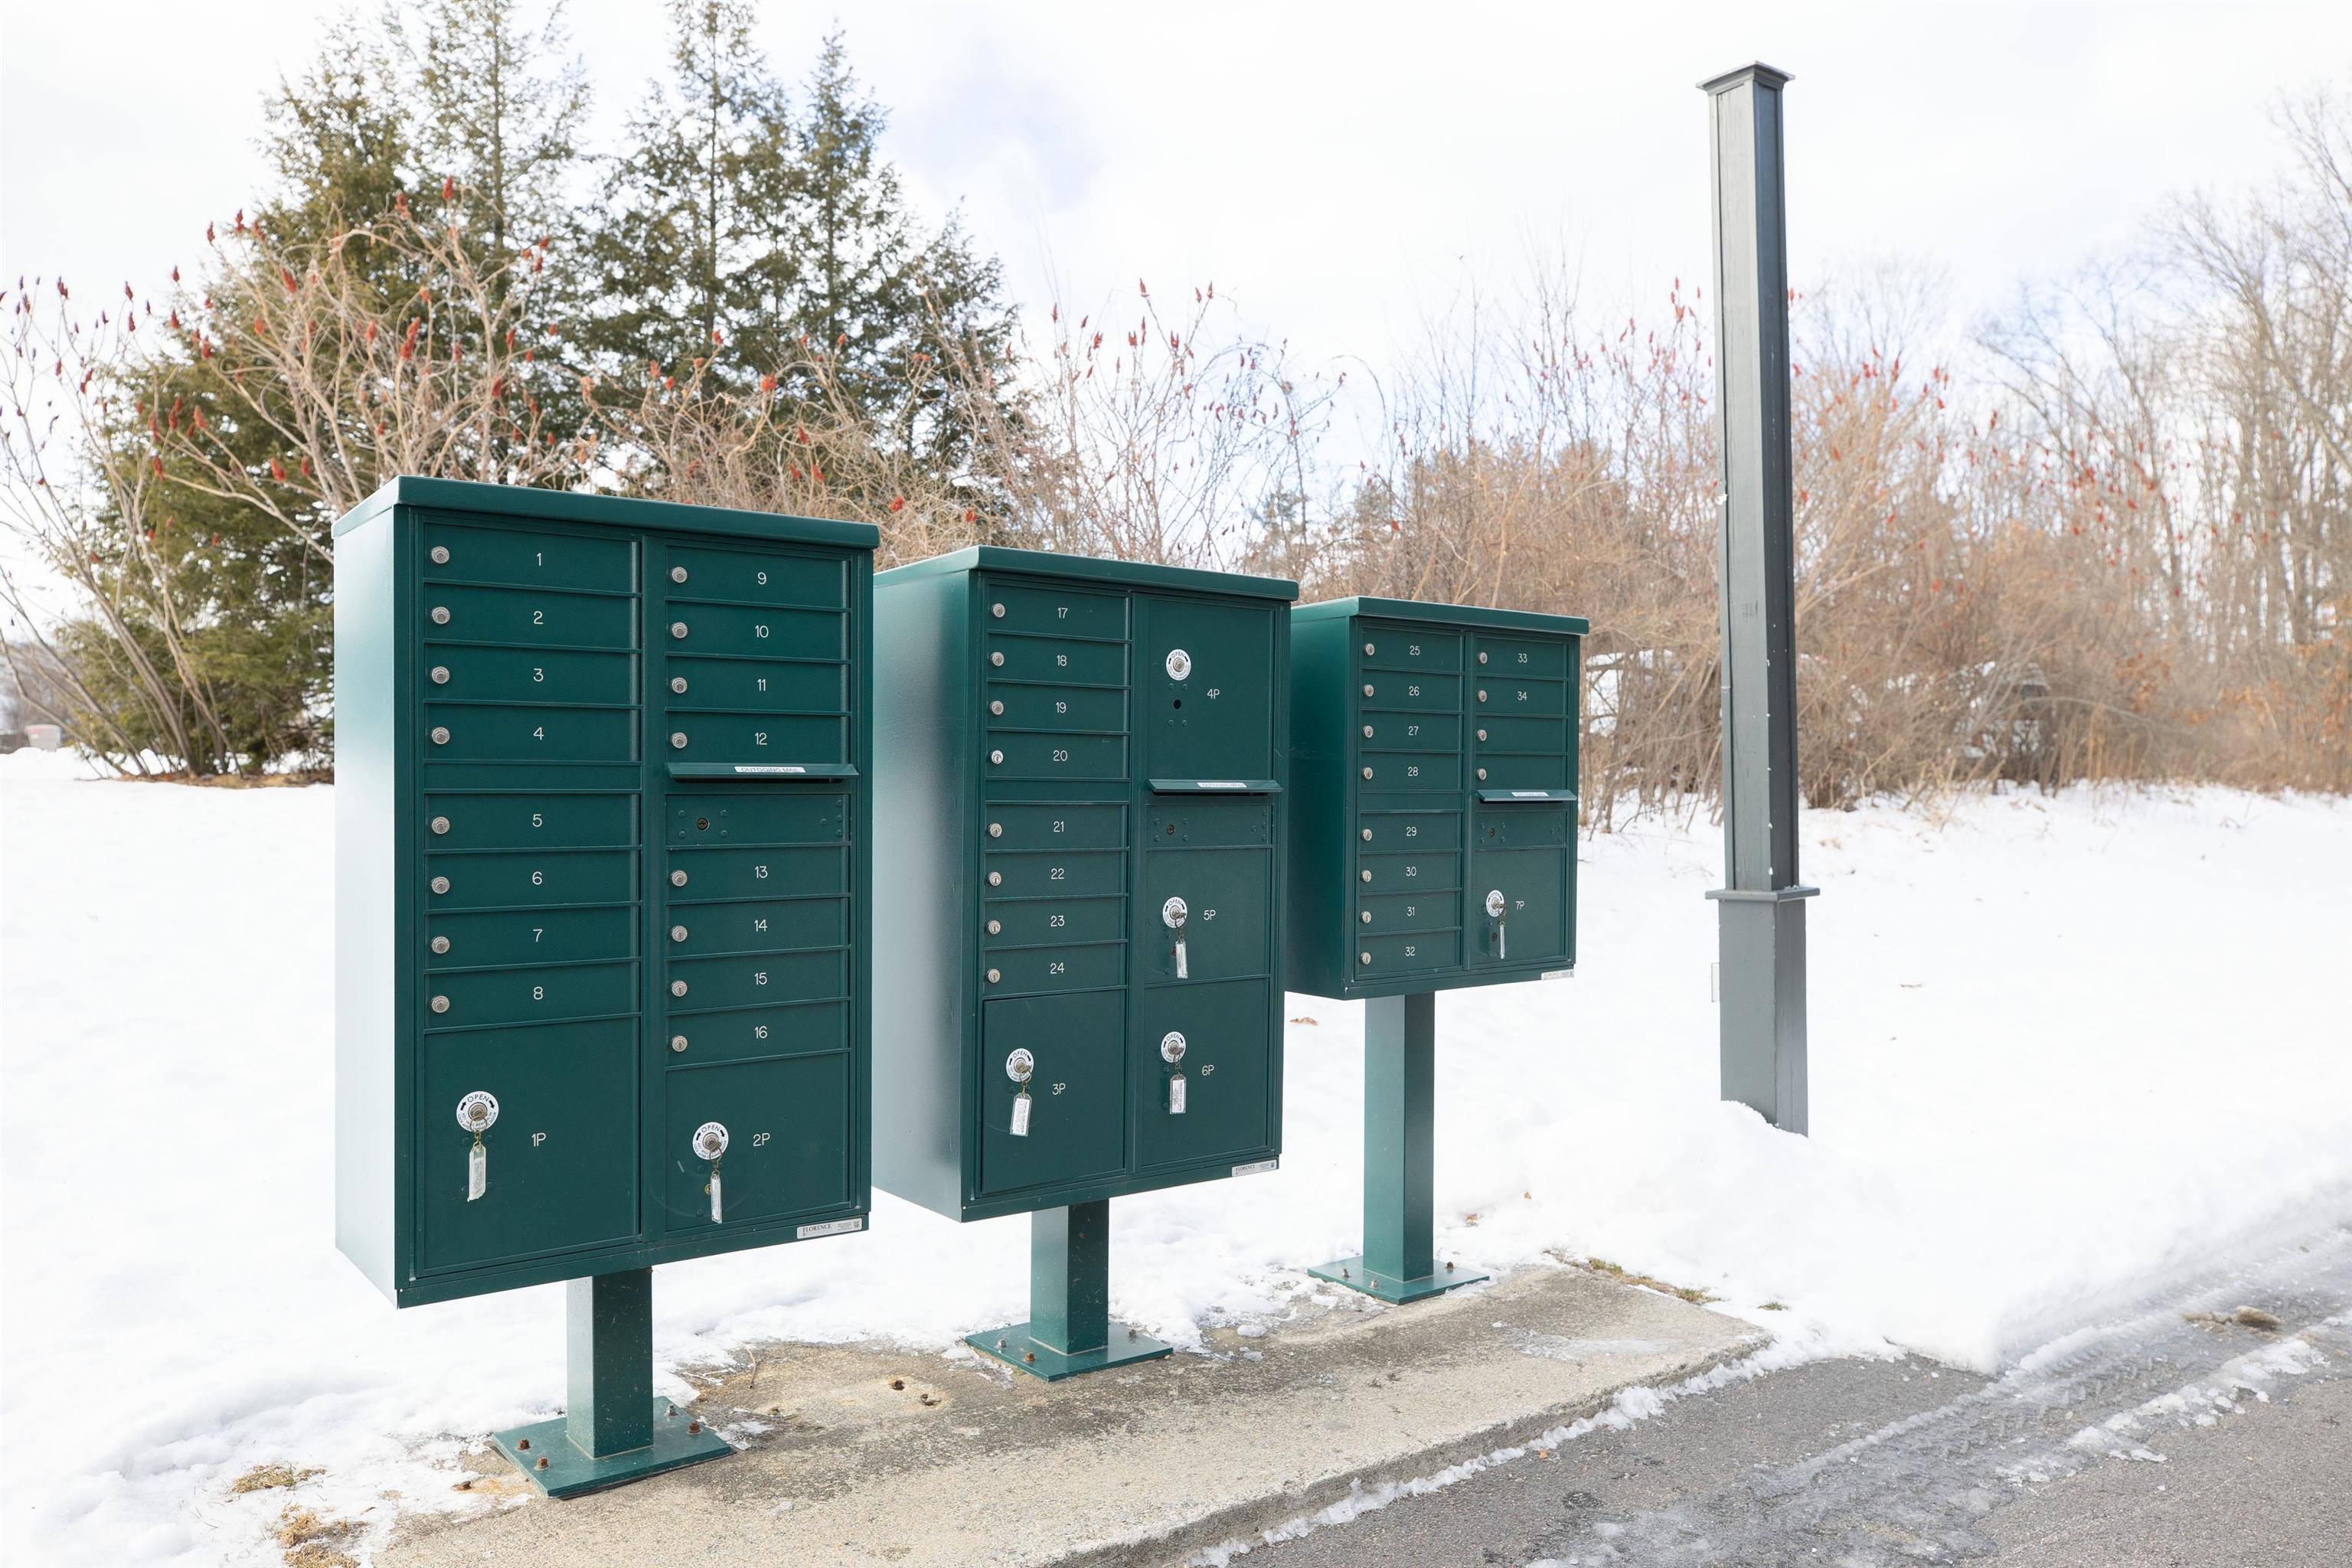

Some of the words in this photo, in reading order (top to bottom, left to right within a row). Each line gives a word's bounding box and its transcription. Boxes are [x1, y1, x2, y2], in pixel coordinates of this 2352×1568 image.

[536, 552, 541, 567] 1
[757, 572, 767, 585] 9
[533, 610, 544, 625] 2
[1057, 607, 1068, 619] 17
[755, 625, 769, 639] 10
[1410, 645, 1420, 656] 25
[1057, 655, 1067, 667] 18
[1517, 652, 1528, 664] 33
[533, 668, 544, 682] 3
[757, 678, 766, 691] 11
[1207, 688, 1220, 700] 4P
[1409, 685, 1419, 697] 26
[1517, 691, 1527, 701] 34
[1055, 701, 1067, 714] 19
[533, 727, 544, 740] 4
[1408, 725, 1419, 736] 27
[754, 732, 768, 746] 12
[1053, 750, 1068, 762] 20
[1407, 766, 1419, 777] 28
[532, 813, 543, 828] 5
[1053, 821, 1064, 833] 21
[1406, 826, 1417, 837] 29
[754, 865, 769, 879] 13
[1050, 867, 1065, 880] 22
[1406, 866, 1417, 877] 30
[531, 871, 543, 886] 6
[1406, 906, 1415, 916] 31
[1515, 900, 1525, 910] 7P
[1050, 915, 1065, 927] 23
[1204, 909, 1217, 921] 5P
[754, 919, 768, 932] 14
[532, 928, 543, 942] 7
[1405, 946, 1416, 957] 32
[1050, 962, 1065, 975] 24
[754, 972, 768, 985] 15
[533, 986, 544, 1001] 8
[754, 1025, 768, 1039] 16
[1167, 1033, 1180, 1041] OPEN
[1012, 1050, 1028, 1059] OPEN
[1201, 1064, 1215, 1076] 6P
[1052, 1083, 1066, 1096] 3P
[467, 1093, 490, 1102] OPEN
[701, 1124, 720, 1133] OPEN
[531, 1132, 547, 1147] 1P
[753, 1132, 770, 1147] 2P
[802, 1223, 832, 1233] FLORENCE
